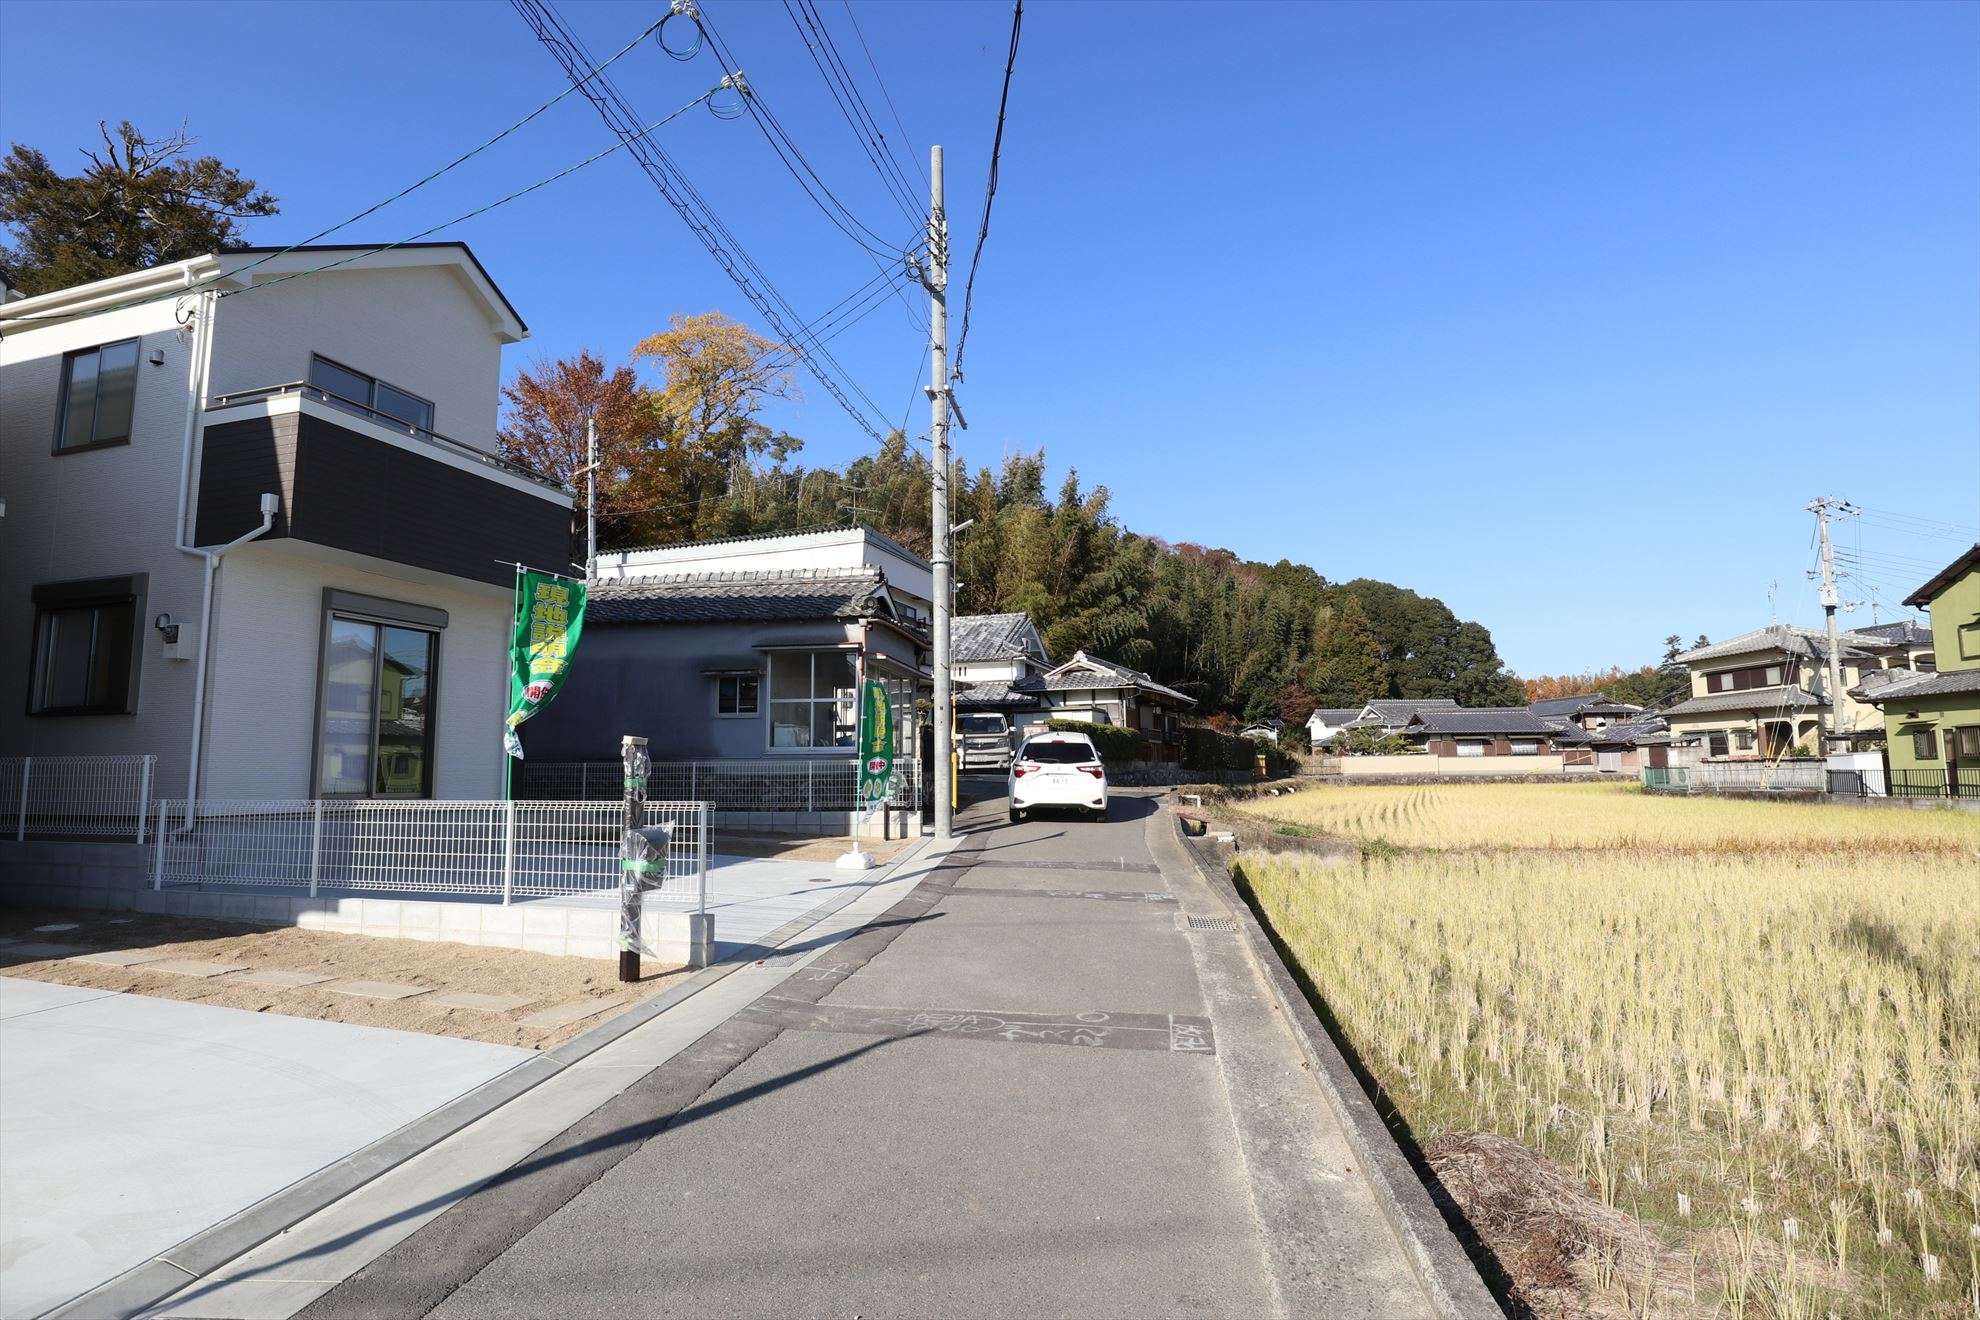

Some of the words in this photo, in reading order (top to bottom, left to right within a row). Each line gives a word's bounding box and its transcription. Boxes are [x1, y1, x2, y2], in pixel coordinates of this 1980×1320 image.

[530, 582, 569, 674] 現地説明会
